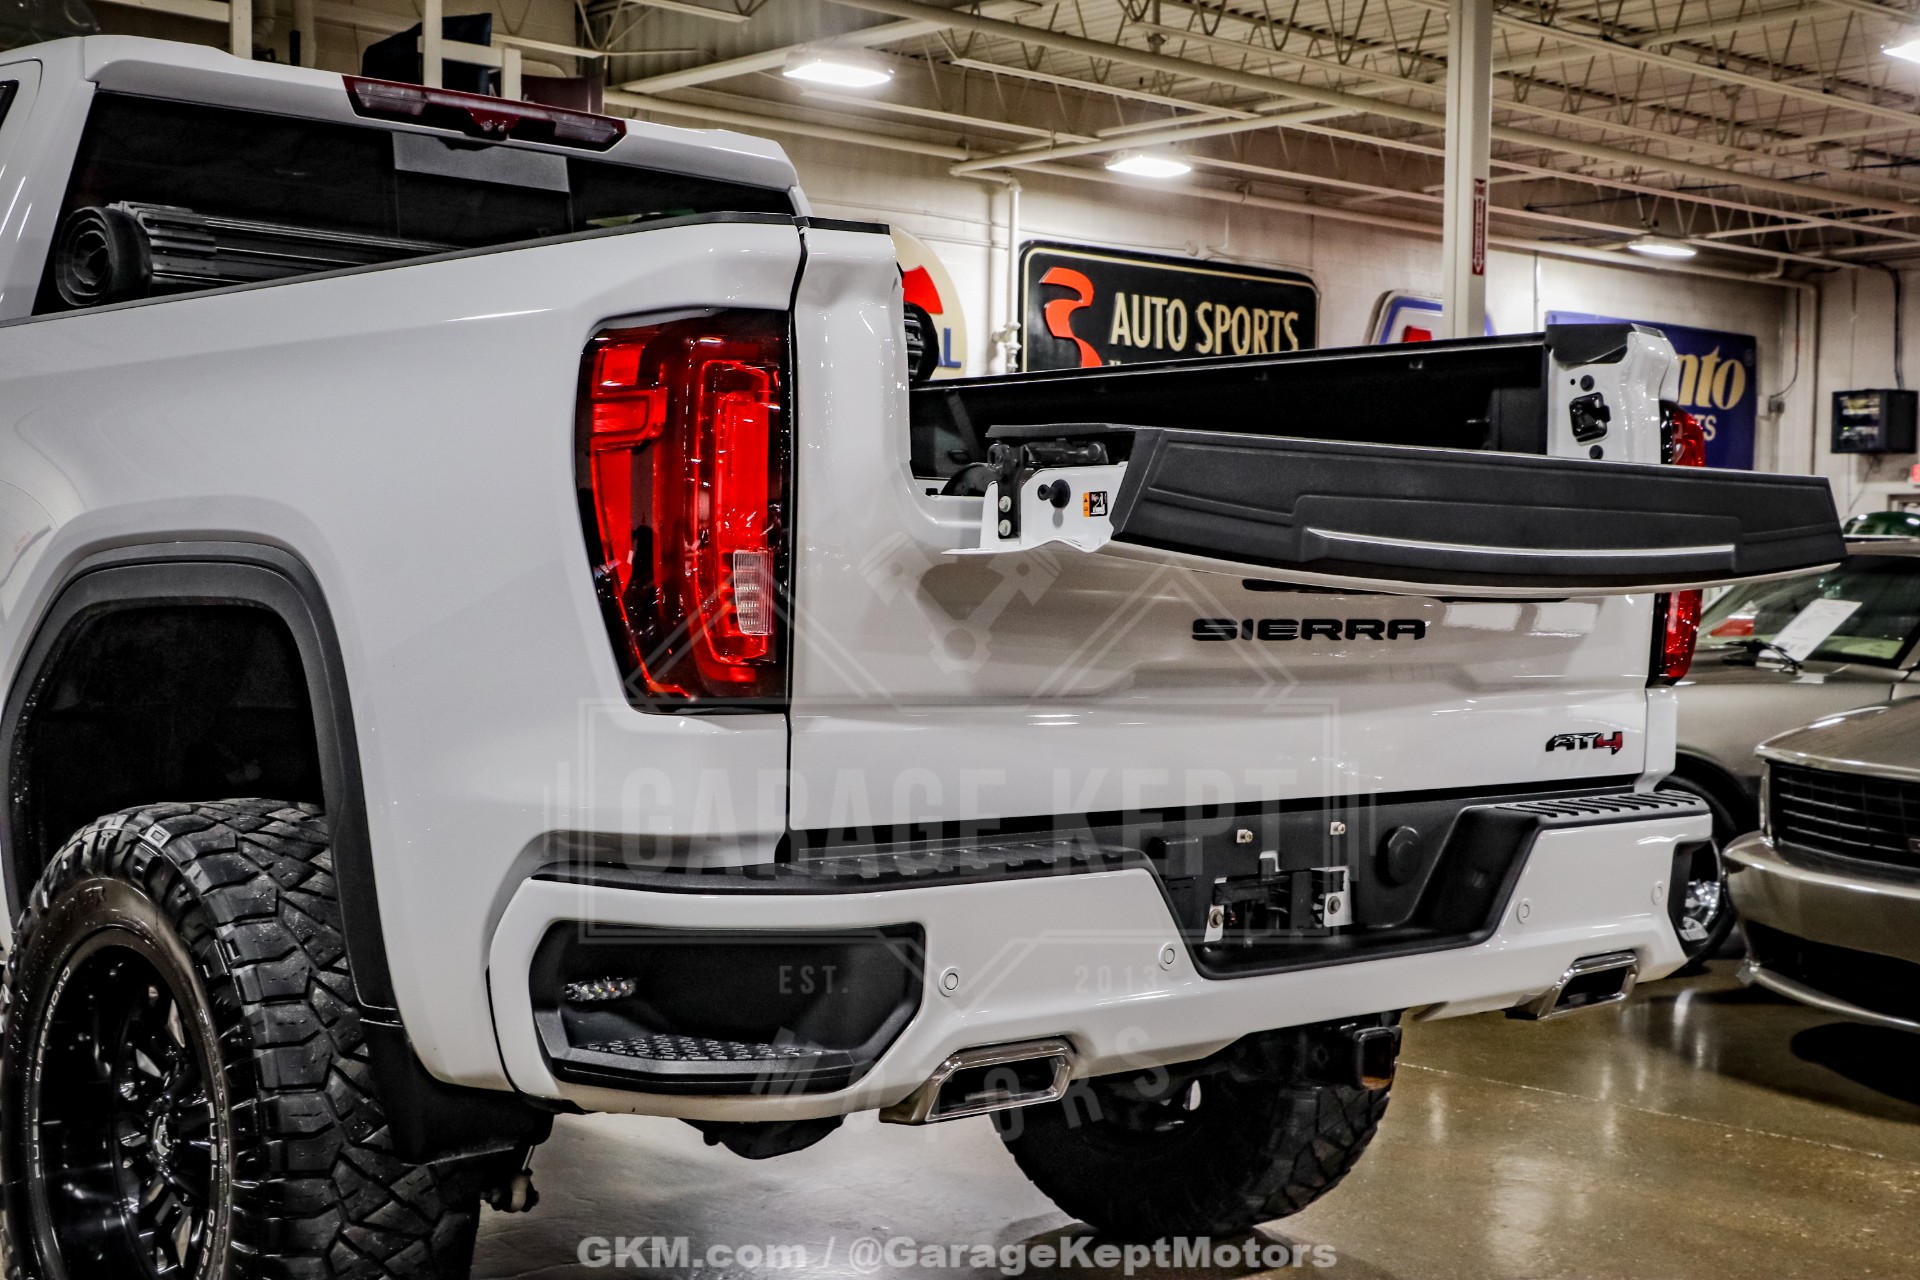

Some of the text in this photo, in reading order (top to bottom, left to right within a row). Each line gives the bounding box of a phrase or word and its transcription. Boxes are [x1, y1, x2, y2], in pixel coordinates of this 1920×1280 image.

[1109, 292, 1299, 355] AUTO SPORTS
[1192, 618, 1427, 642] SIERRA
[1545, 731, 1624, 755] AT4
[207, 1101, 218, 1181] FUEL
